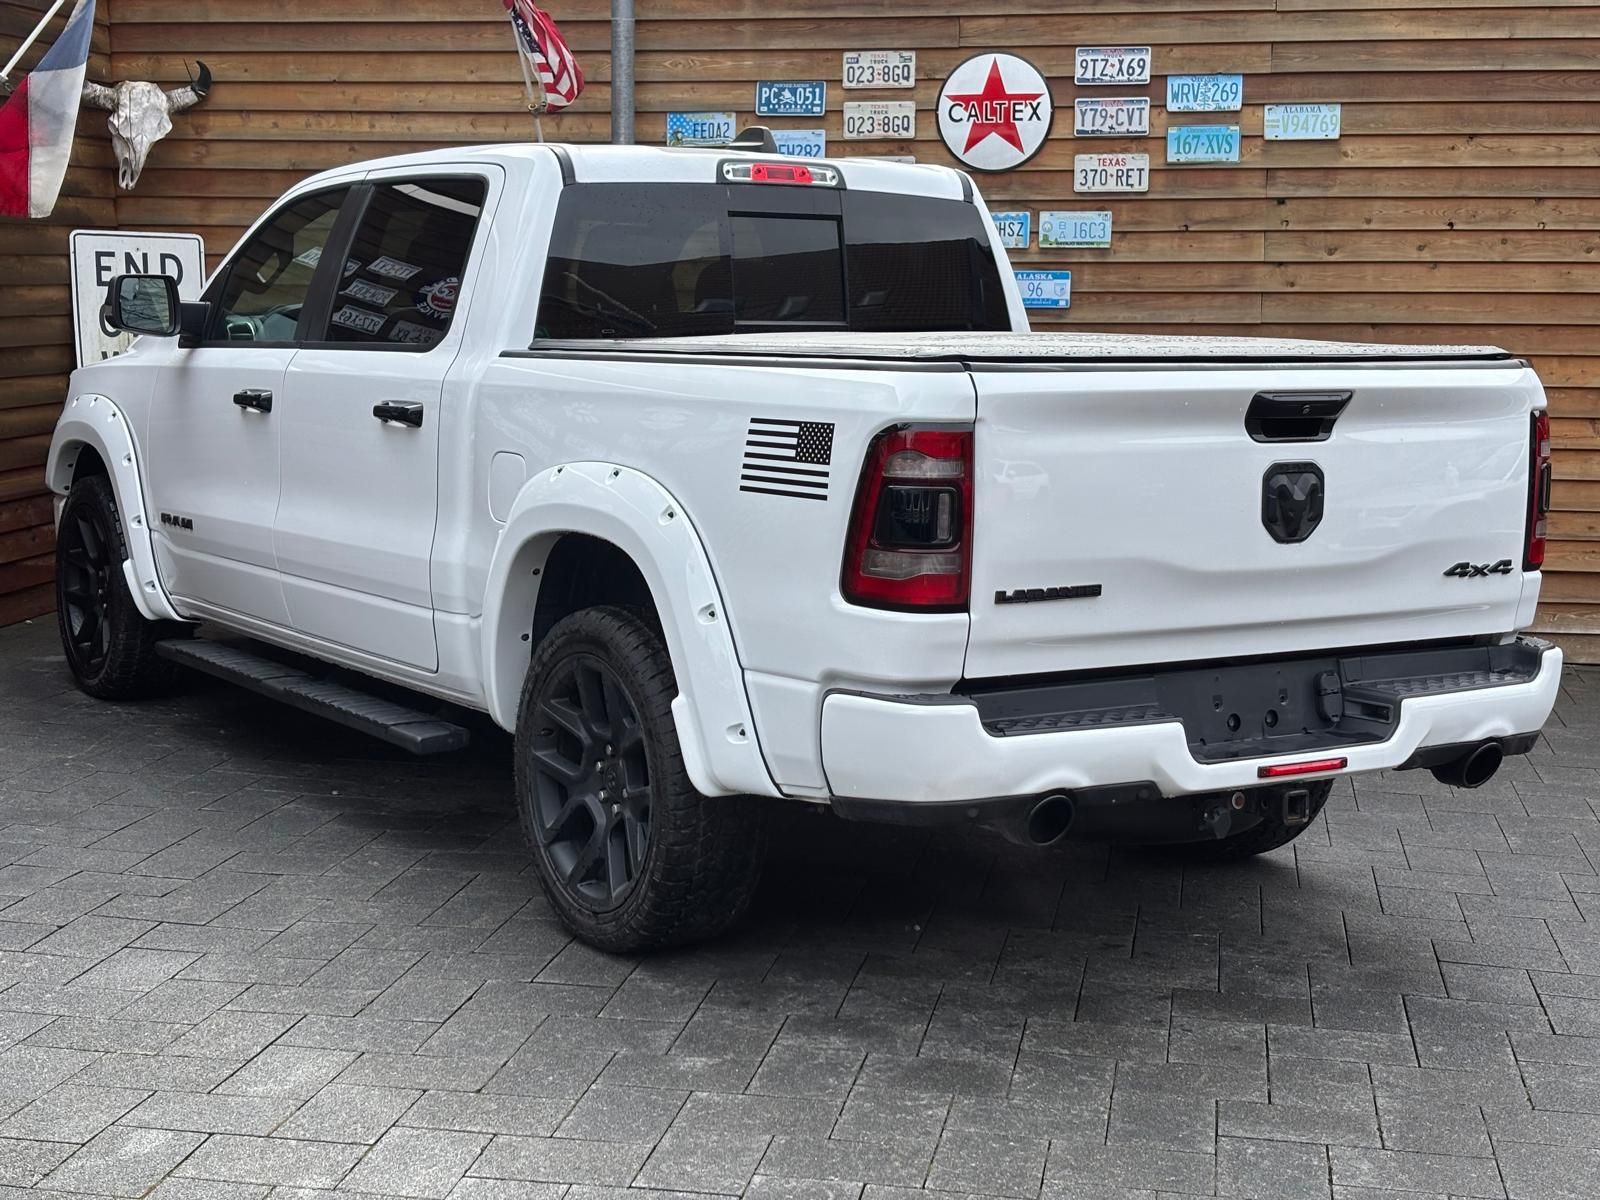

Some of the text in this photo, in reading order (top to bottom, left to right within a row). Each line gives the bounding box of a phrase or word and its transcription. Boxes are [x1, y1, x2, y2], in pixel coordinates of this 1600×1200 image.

[761, 87, 822, 104] PC 051
[948, 101, 1042, 123] CALTEX
[1283, 105, 1322, 114] ALABAMA
[1281, 114, 1338, 133] V94769
[1097, 157, 1127, 167] TEXAS
[94, 250, 184, 287] END
[1442, 559, 1515, 578] 4x4
